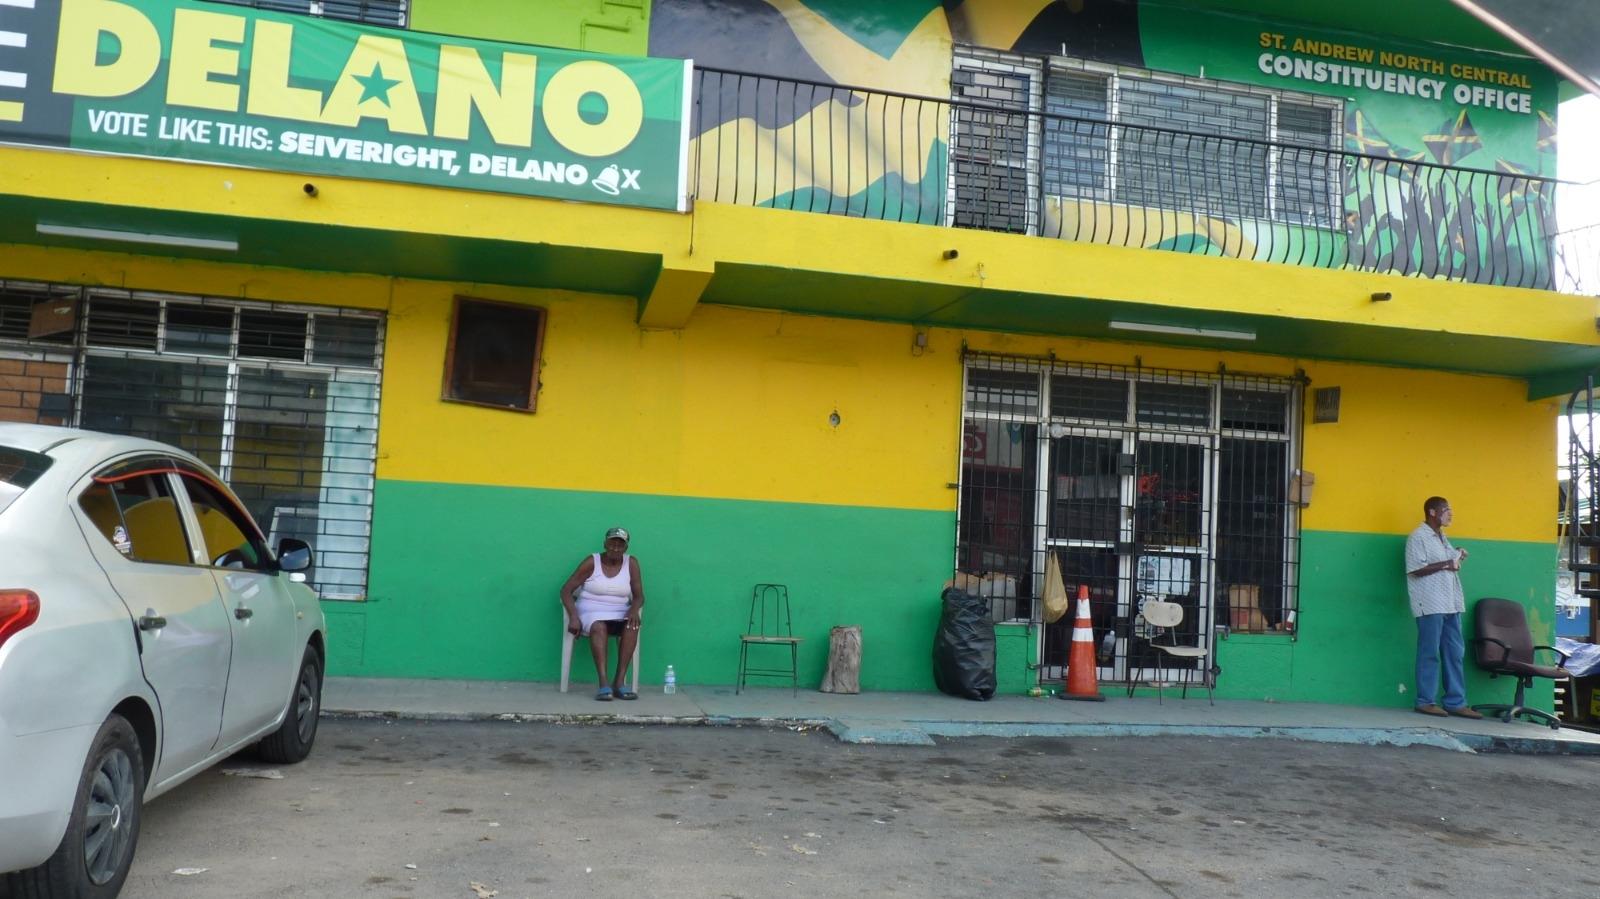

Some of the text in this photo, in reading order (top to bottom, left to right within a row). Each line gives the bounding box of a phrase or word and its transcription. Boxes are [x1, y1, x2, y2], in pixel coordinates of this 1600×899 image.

[53, 0, 643, 157] DELANO
[1258, 53, 1532, 114] CONSTITUENCY OFFICE
[1260, 32, 1532, 88] ST. ANDREW NORTH CENTRAL
[88, 109, 641, 190] VOTE LIKE THIS: SEIVERIGHT, DELANO X
